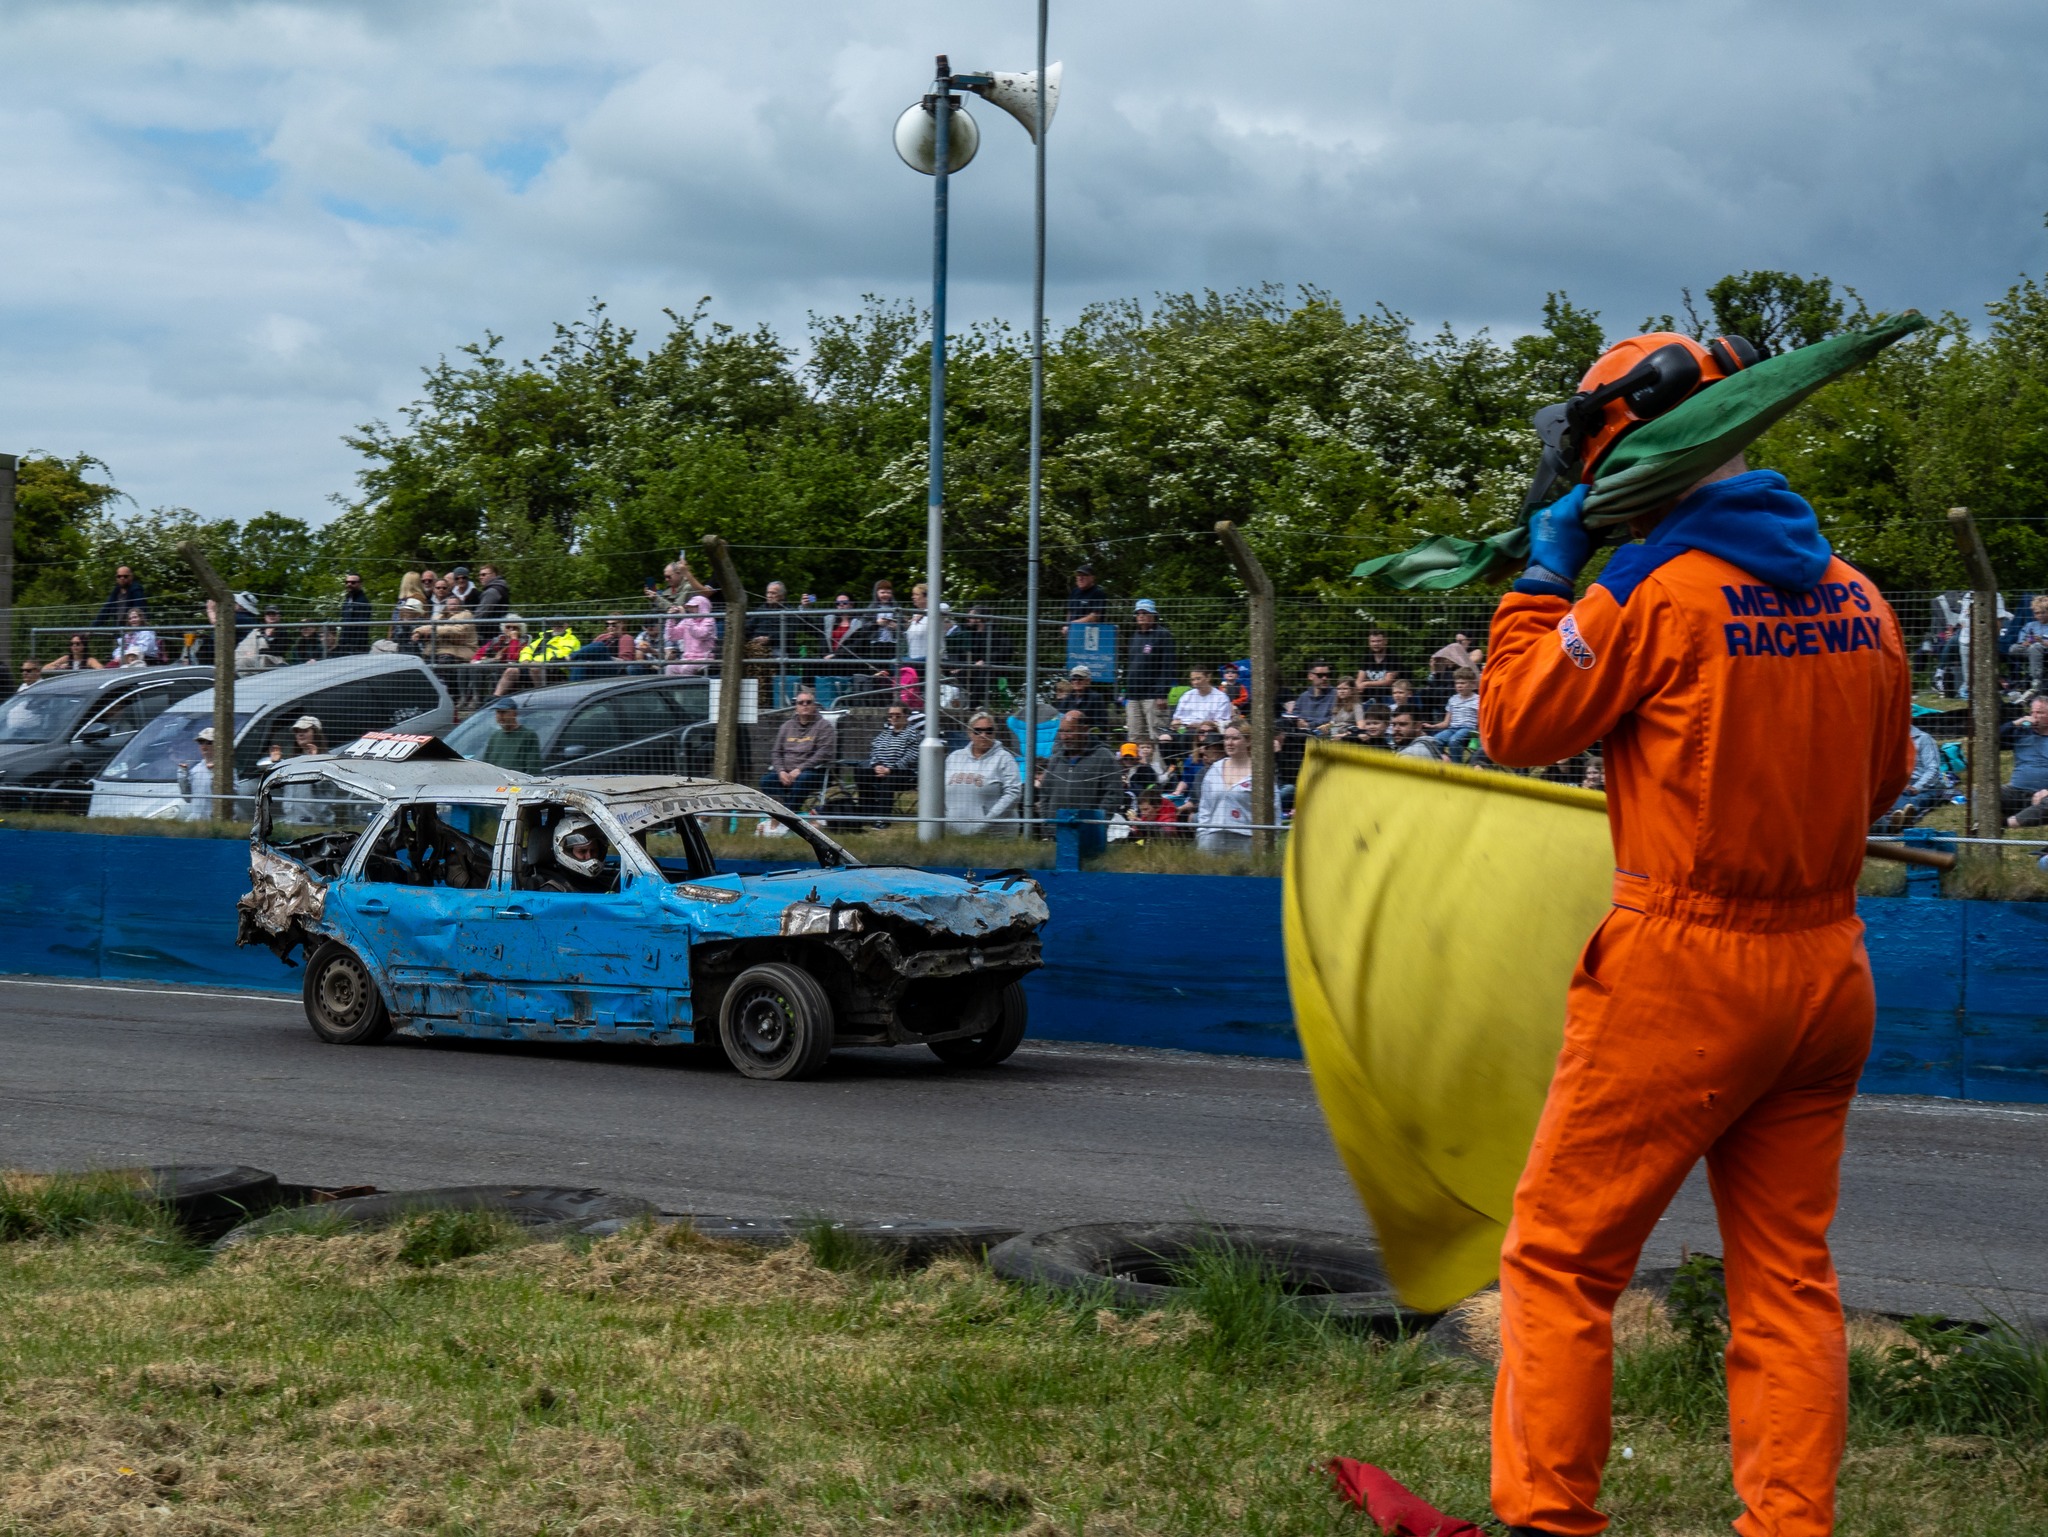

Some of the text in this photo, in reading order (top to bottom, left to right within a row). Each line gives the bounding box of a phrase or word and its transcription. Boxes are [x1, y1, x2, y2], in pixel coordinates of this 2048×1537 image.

[1721, 580, 1872, 618] MENDIPS
[1723, 617, 1882, 658] RACEWAY
[343, 738, 420, 762] 440
